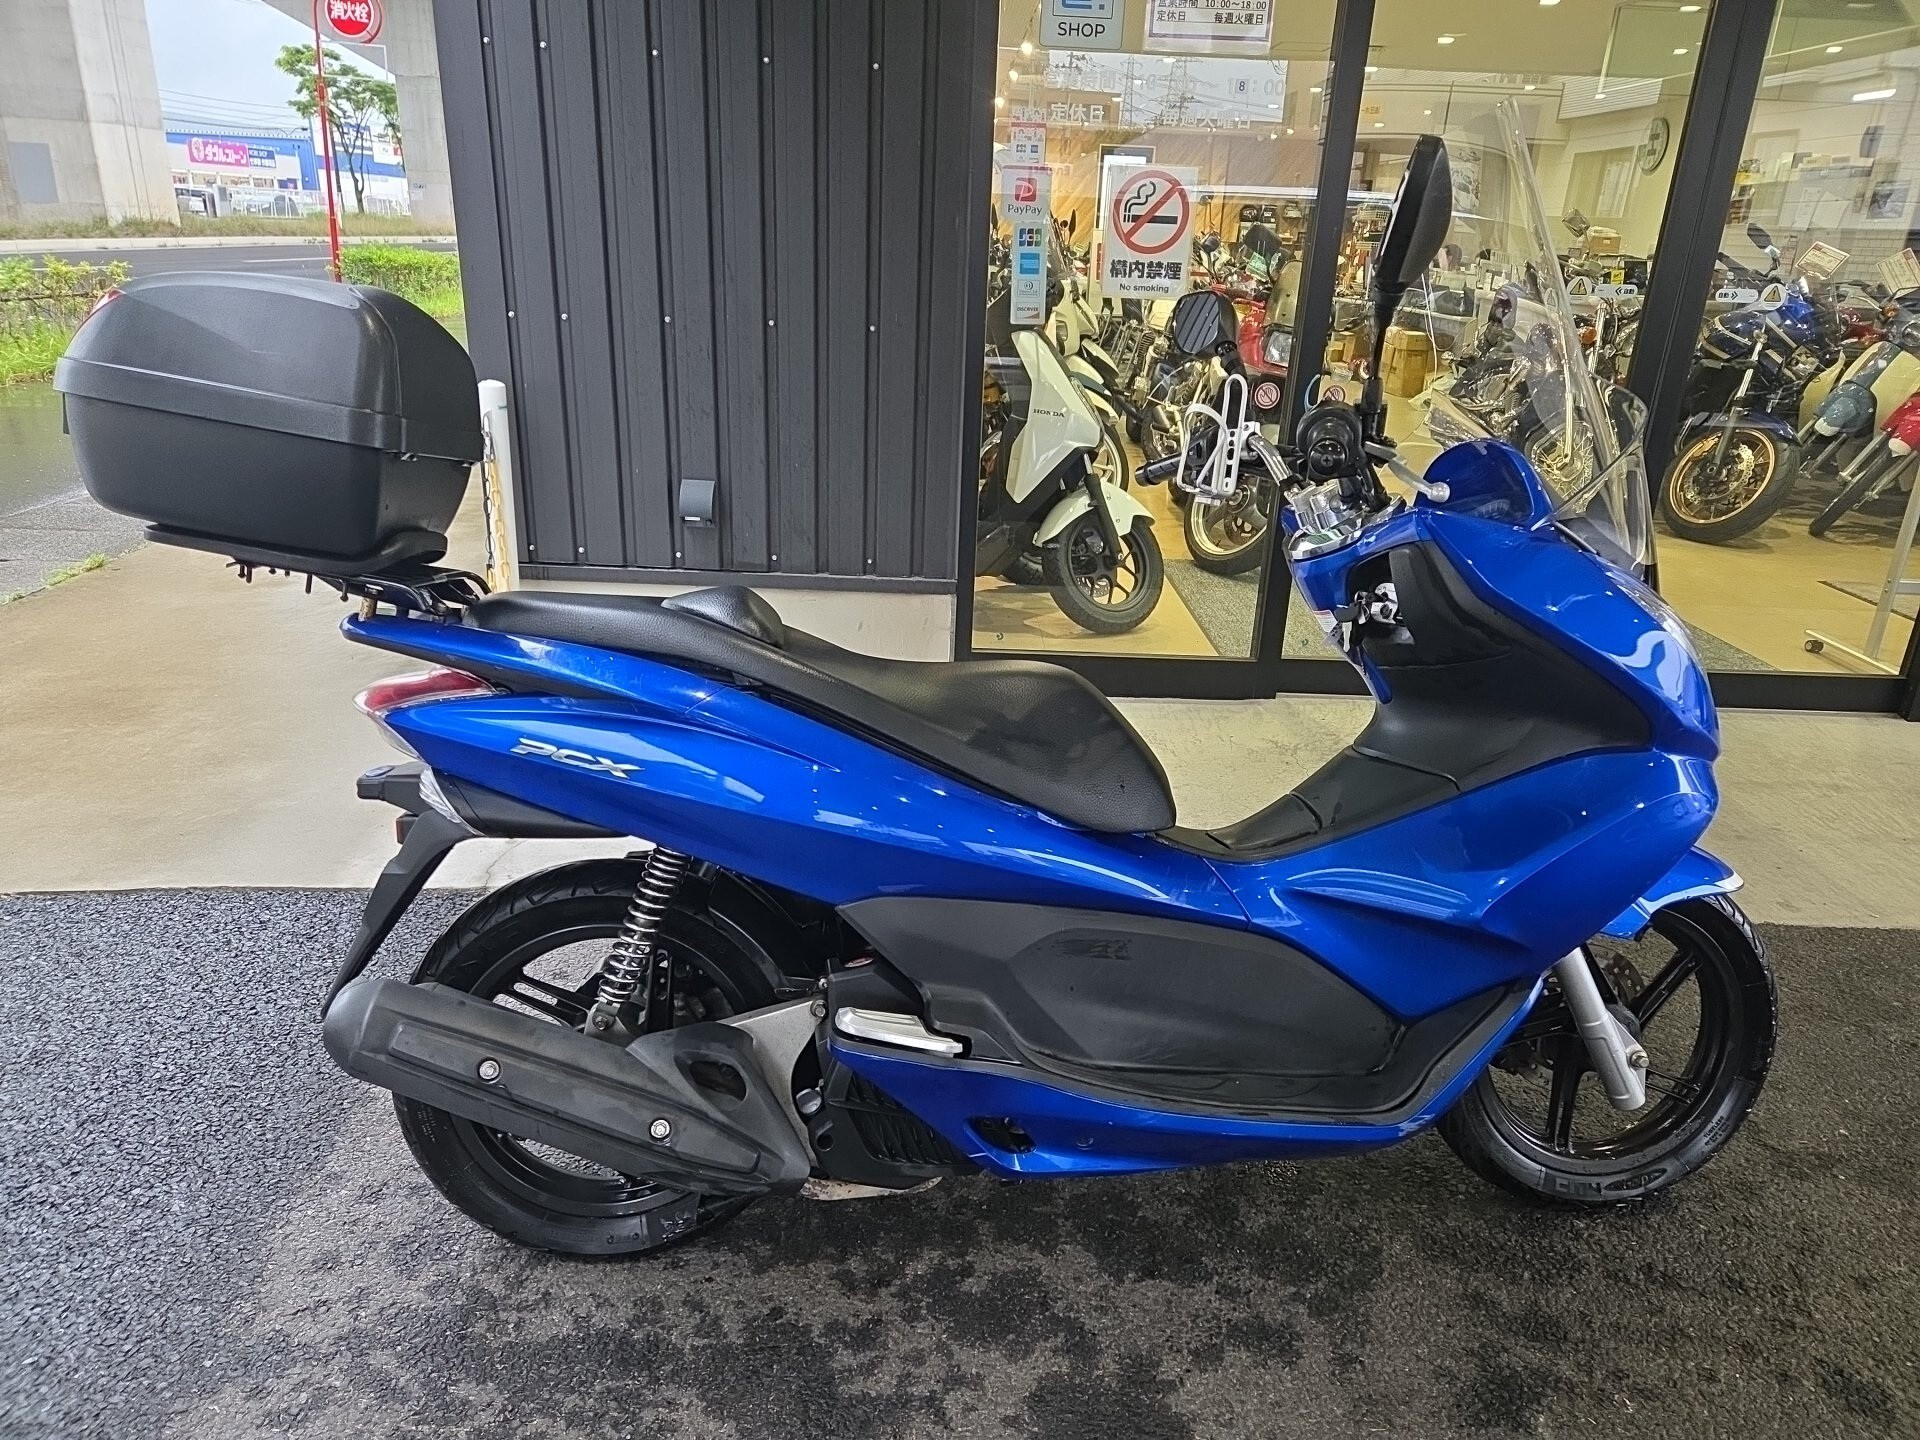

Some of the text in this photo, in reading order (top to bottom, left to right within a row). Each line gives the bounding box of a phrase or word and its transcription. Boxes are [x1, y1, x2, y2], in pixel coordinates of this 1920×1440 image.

[330, 0, 369, 23] 消火栓
[1157, 10, 1264, 24] 定休日 毎週火曜日
[1057, 22, 1106, 38] SHOP
[1050, 103, 1251, 129] 定休日 毎週火曜日
[205, 144, 247, 164] ダブルストーン
[1008, 204, 1042, 216] PayPay
[1019, 232, 1042, 243] JCB
[1110, 259, 1182, 280] 構内禁煙
[1119, 283, 1169, 293] No smoking
[1033, 408, 1065, 417] HONDA
[510, 737, 645, 779] PCX
